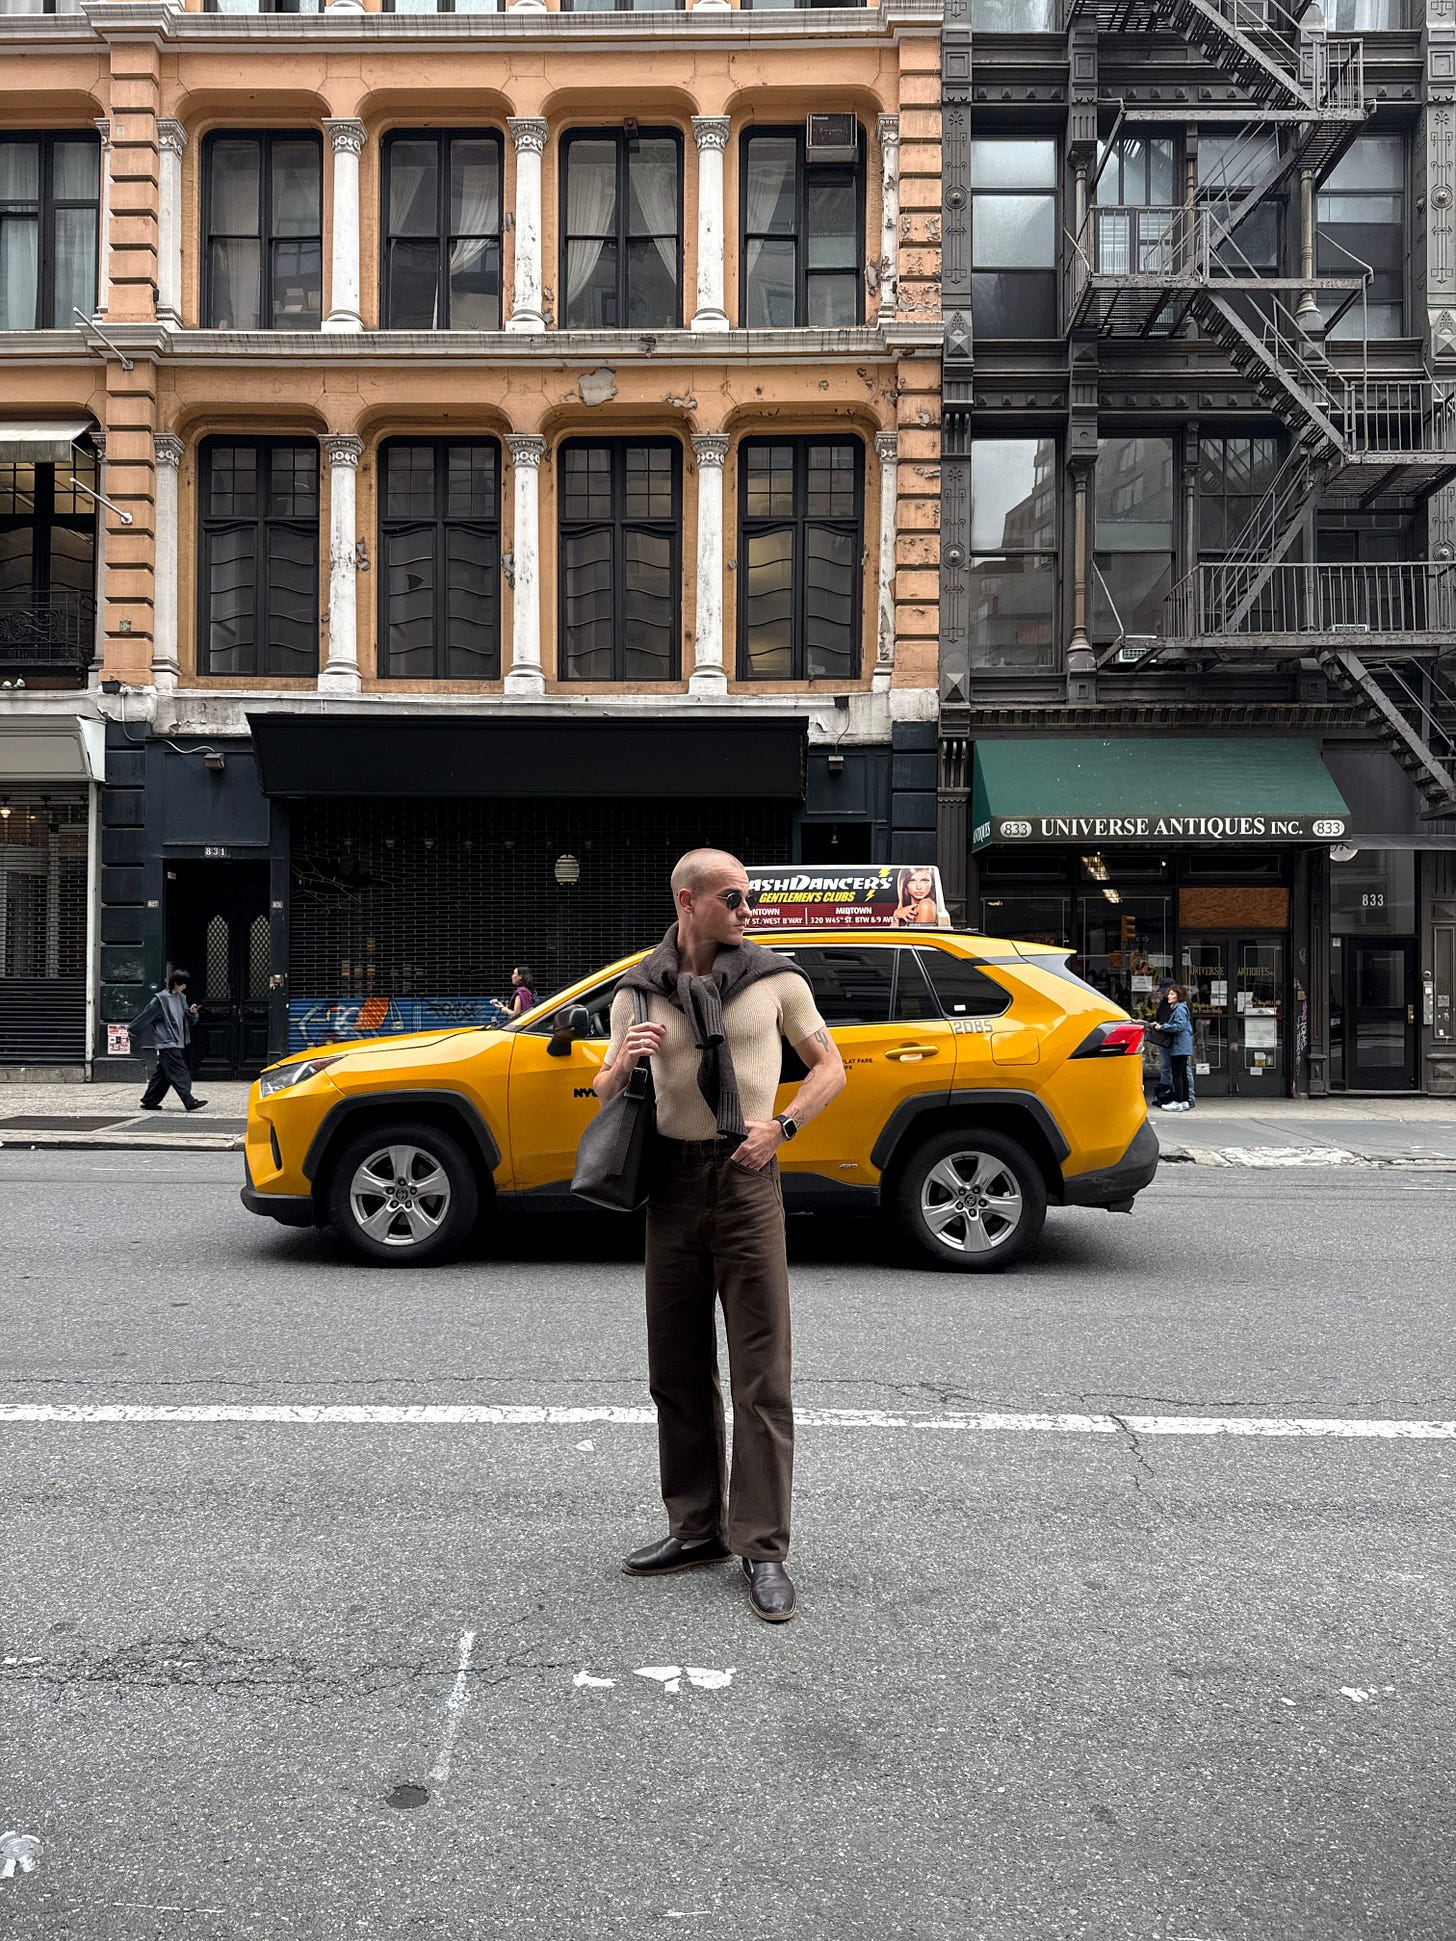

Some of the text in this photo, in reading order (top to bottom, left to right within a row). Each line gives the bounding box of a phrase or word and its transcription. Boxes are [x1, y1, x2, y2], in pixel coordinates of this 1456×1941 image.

[1004, 817, 1303, 838] 833 UNIVERSE ANTIQUES INC.
[1317, 822, 1341, 834] 833
[205, 847, 225, 856] 831
[749, 874, 893, 891] ASHDANCERS
[759, 892, 855, 903] GENTLEMEN'S CLUBS
[1362, 894, 1384, 906] 833
